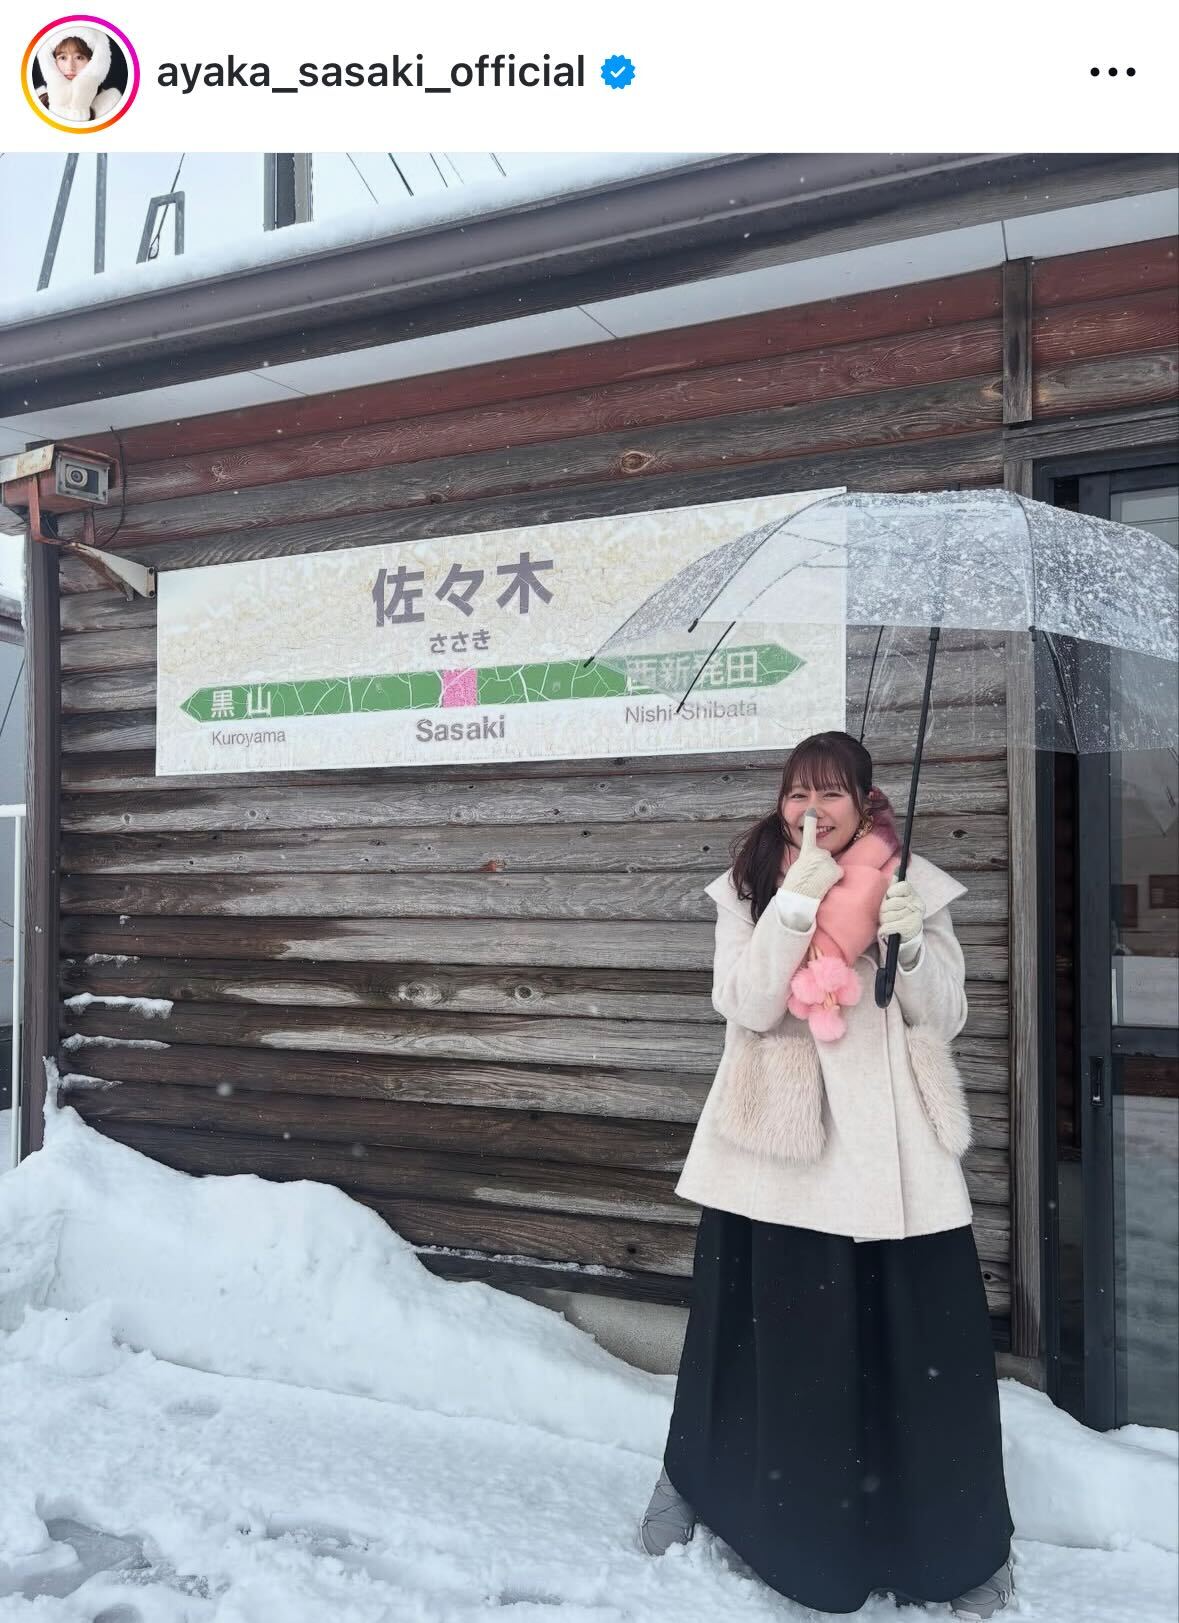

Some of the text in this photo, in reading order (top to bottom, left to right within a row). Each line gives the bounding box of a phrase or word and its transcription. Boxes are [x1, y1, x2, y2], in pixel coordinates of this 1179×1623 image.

[372, 552, 554, 627] 佐々木
[429, 629, 491, 654] ささき
[210, 686, 272, 718] 黒山
[212, 729, 286, 747] Kuroyama
[415, 714, 505, 743] Sasaki
